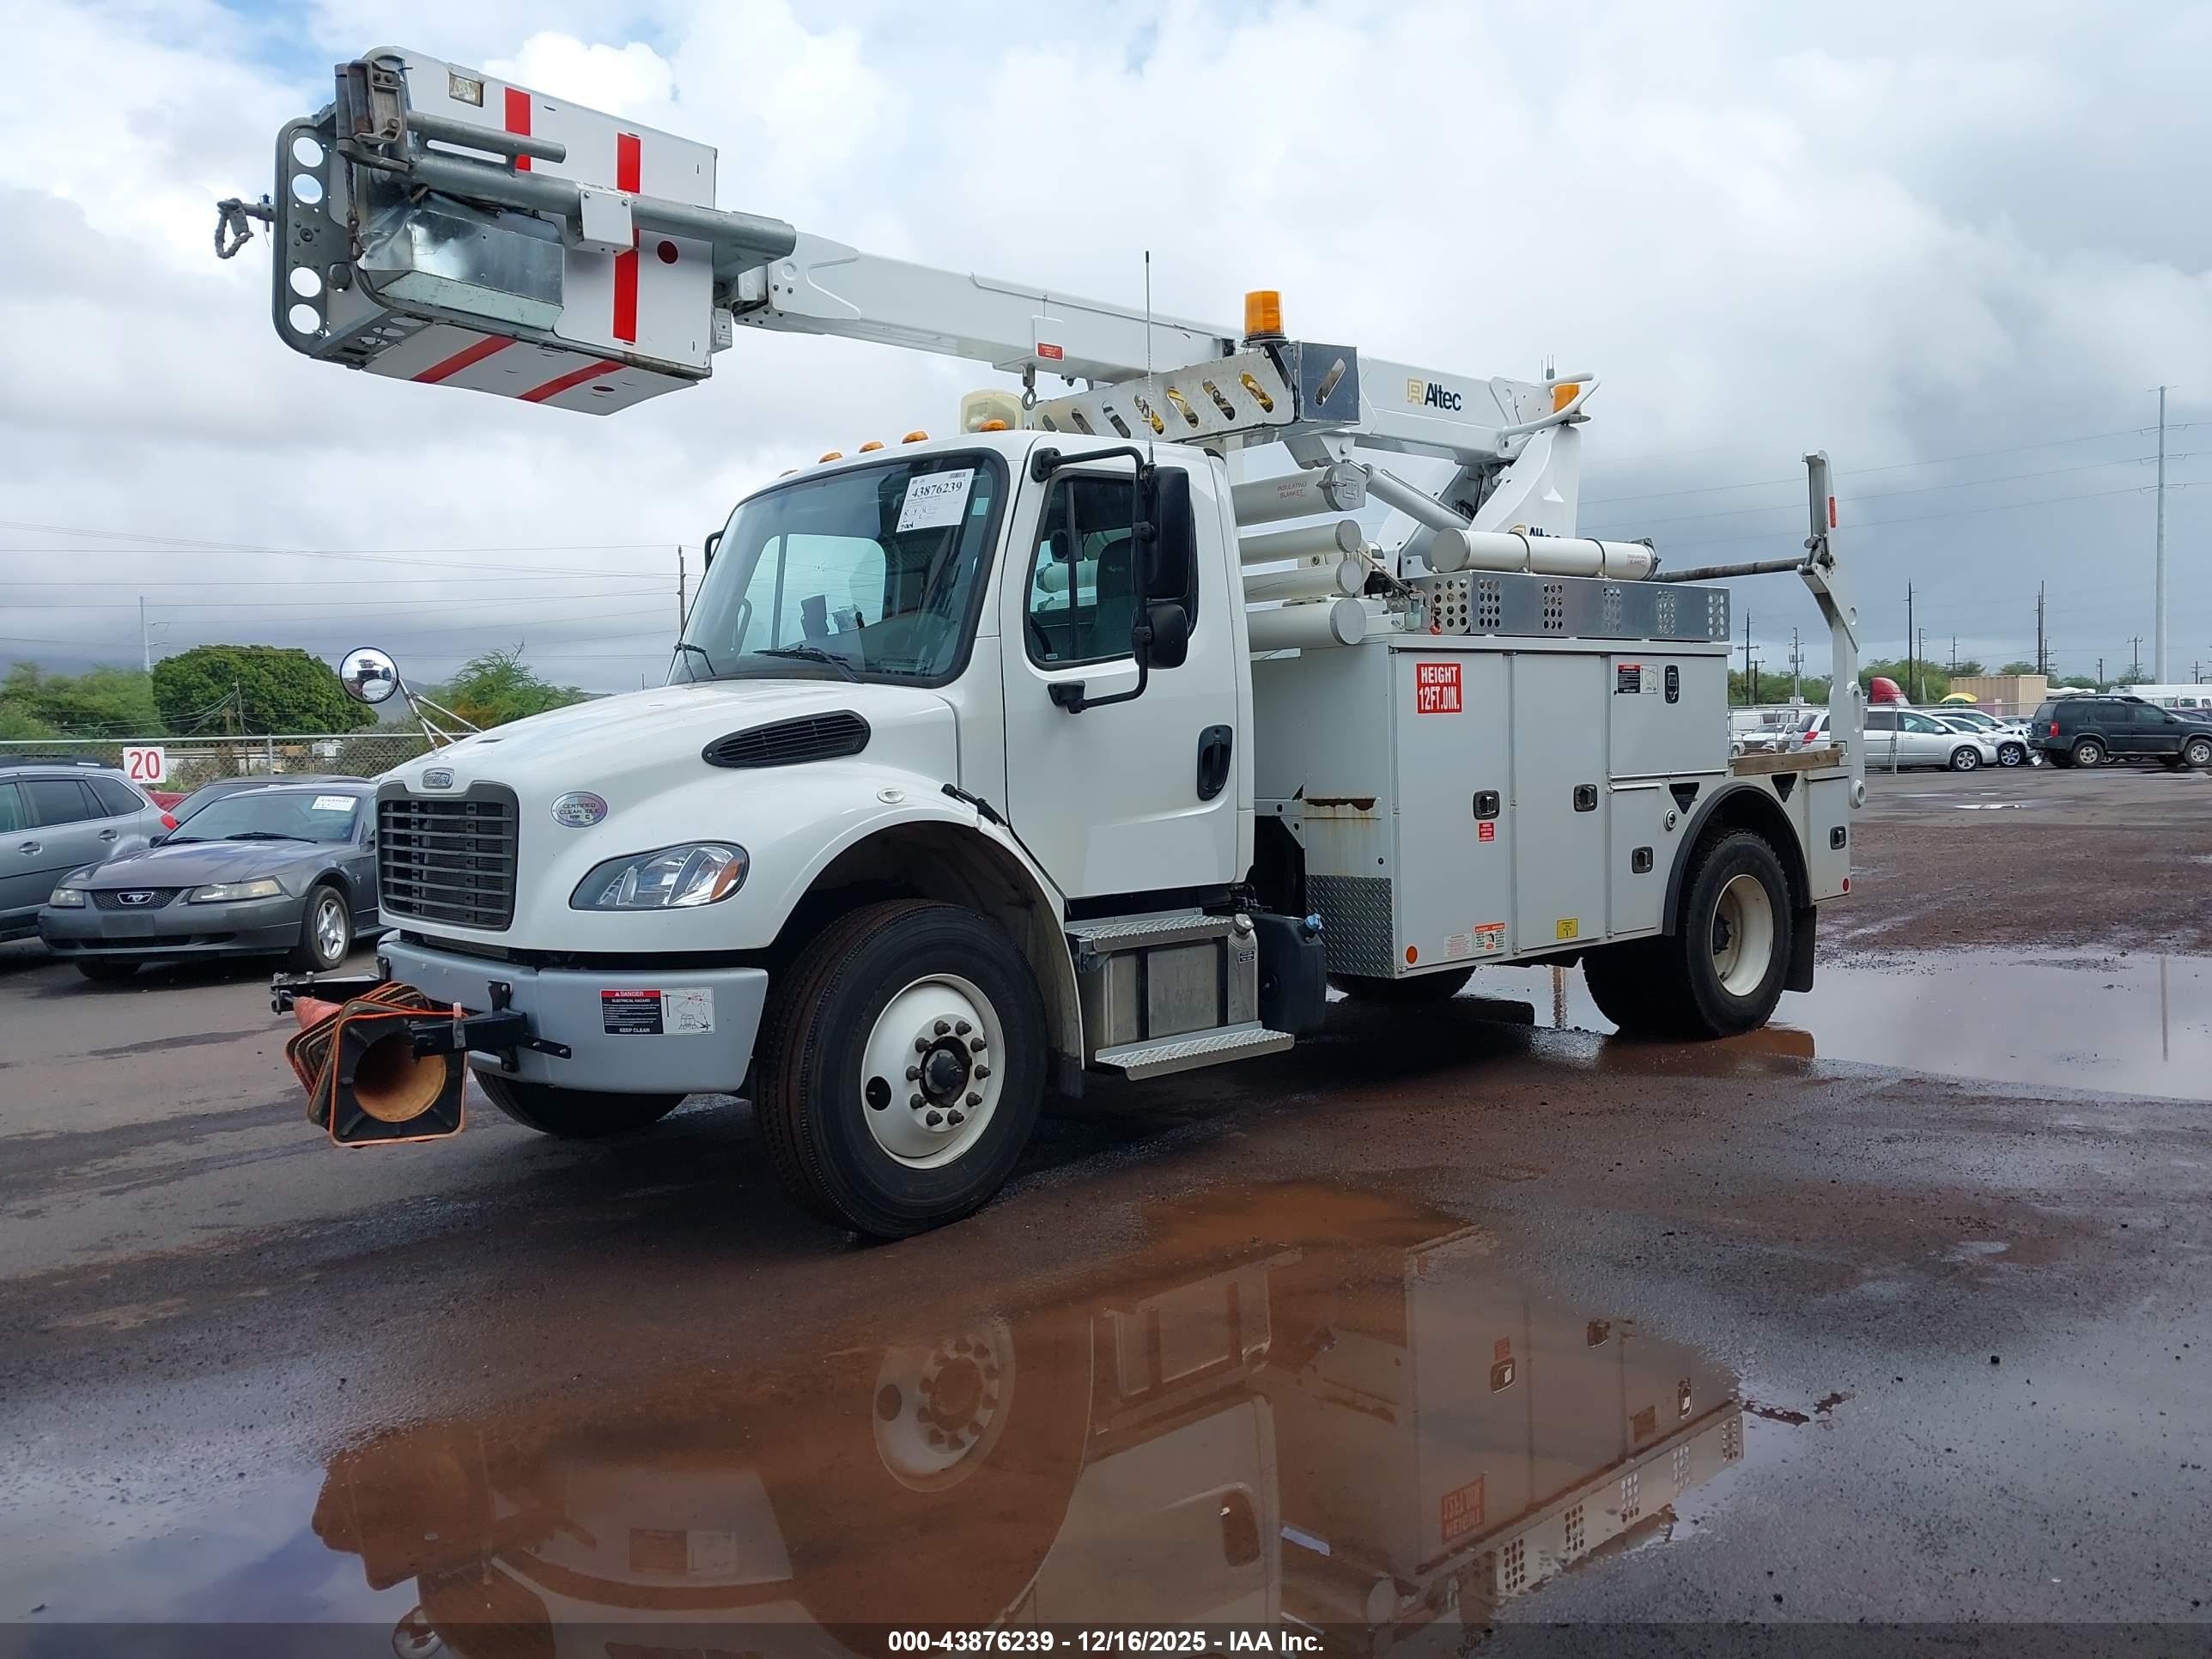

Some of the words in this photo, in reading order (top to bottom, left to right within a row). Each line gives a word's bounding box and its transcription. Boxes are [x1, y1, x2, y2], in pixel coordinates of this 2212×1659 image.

[1425, 383, 1462, 411] Altec
[912, 482, 963, 498] 43876239
[1421, 666, 1458, 684] HEIGHT
[130, 751, 160, 779] 20
